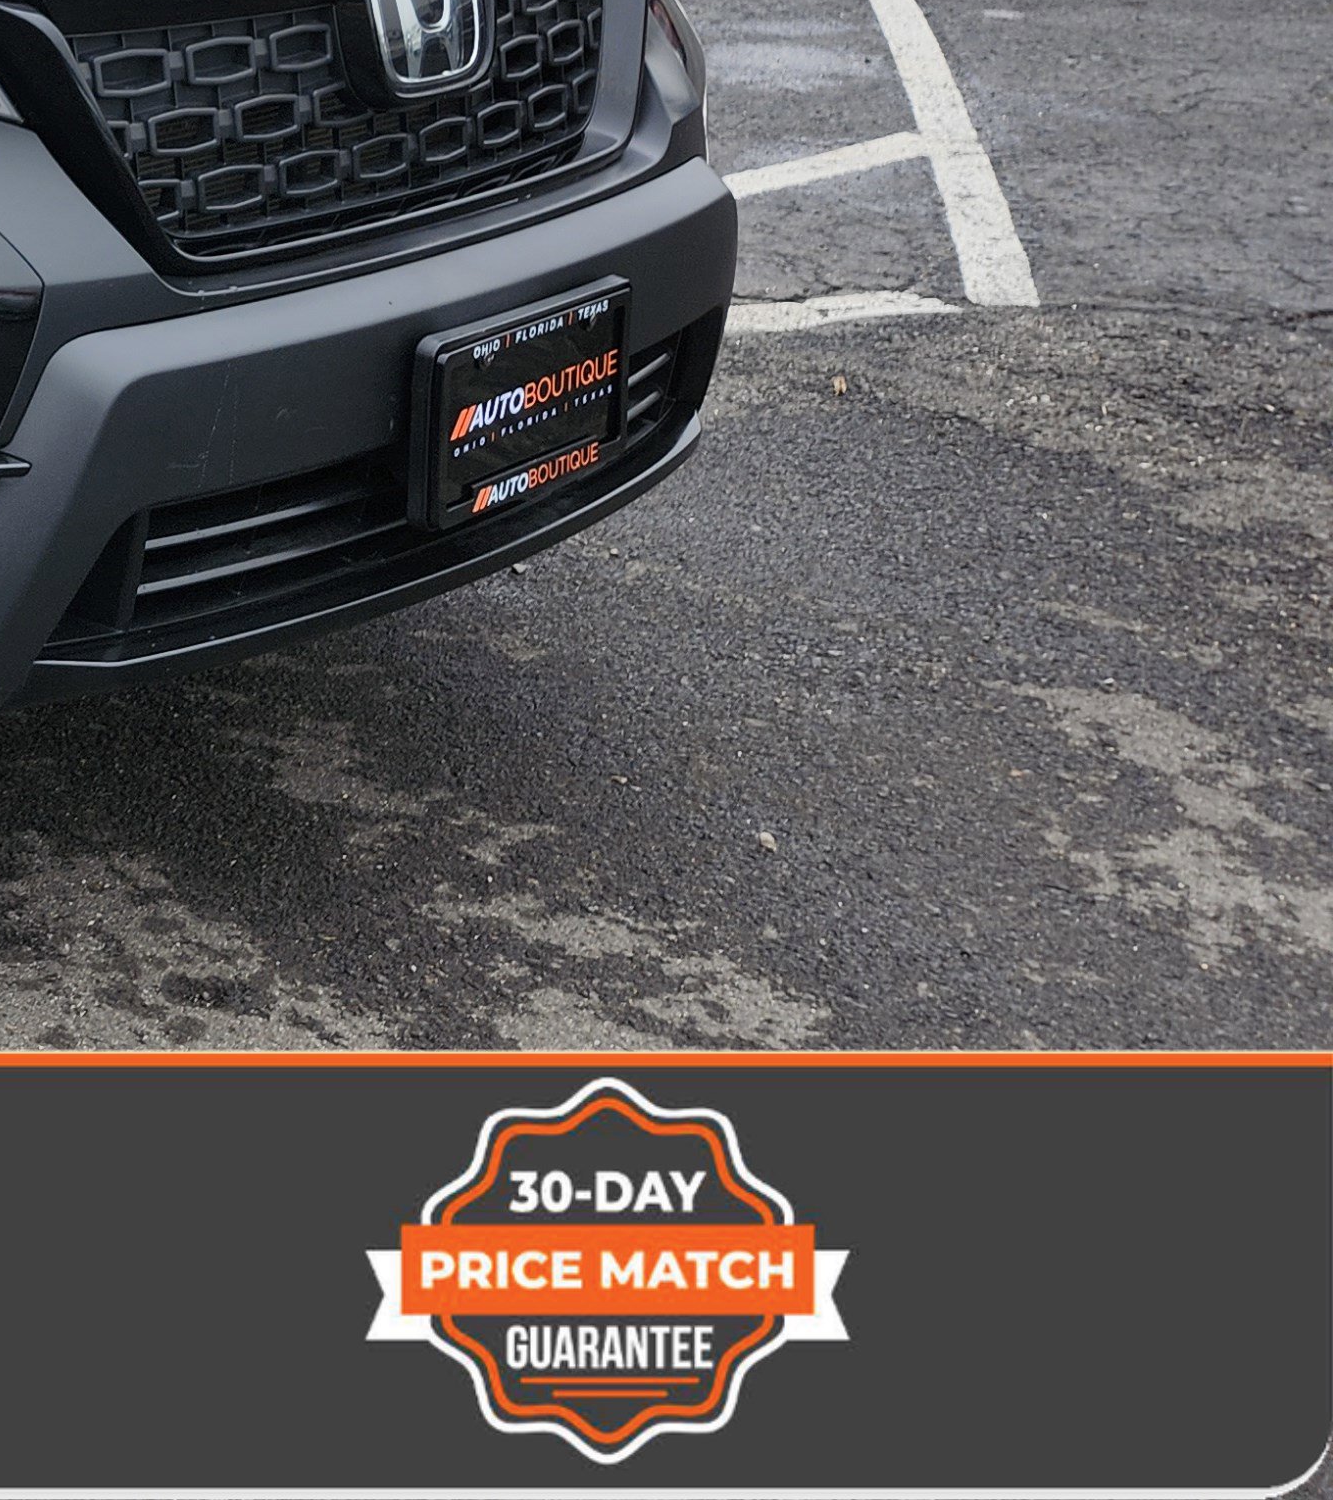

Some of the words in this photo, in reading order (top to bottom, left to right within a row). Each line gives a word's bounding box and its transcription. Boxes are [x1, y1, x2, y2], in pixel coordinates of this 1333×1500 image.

[473, 339, 500, 360] OHIO
[515, 316, 564, 344] FLORIDA
[577, 299, 609, 321] TEXAS
[453, 437, 486, 458] OHIO
[500, 408, 557, 437] FLORIDA
[574, 384, 613, 407] TEXAS
[469, 349, 618, 432] AUTOBOUTIQUE
[487, 442, 599, 506] AUTOBOUTIQUE
